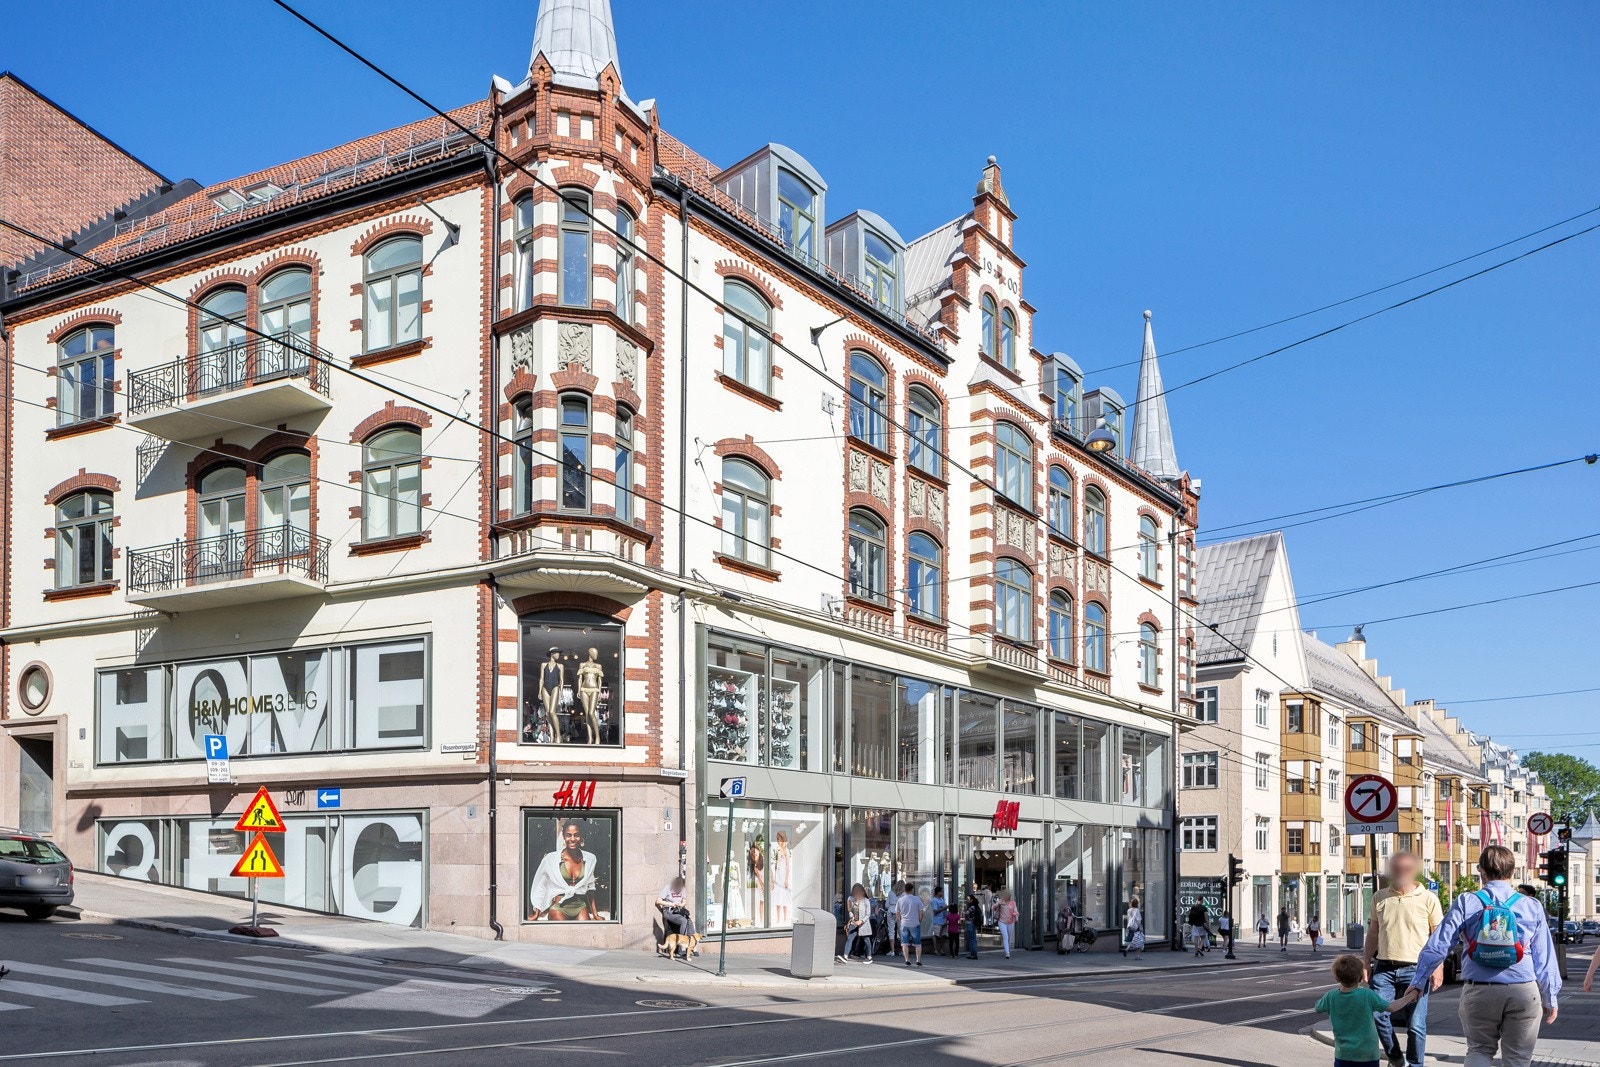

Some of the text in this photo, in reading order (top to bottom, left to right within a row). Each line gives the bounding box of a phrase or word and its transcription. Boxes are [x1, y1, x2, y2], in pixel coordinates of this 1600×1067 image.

[983, 257, 992, 274] 19
[100, 640, 424, 761] HOME
[193, 699, 224, 719] H&M
[228, 695, 273, 716] HOME
[210, 738, 222, 757] P
[552, 779, 597, 809] H&M
